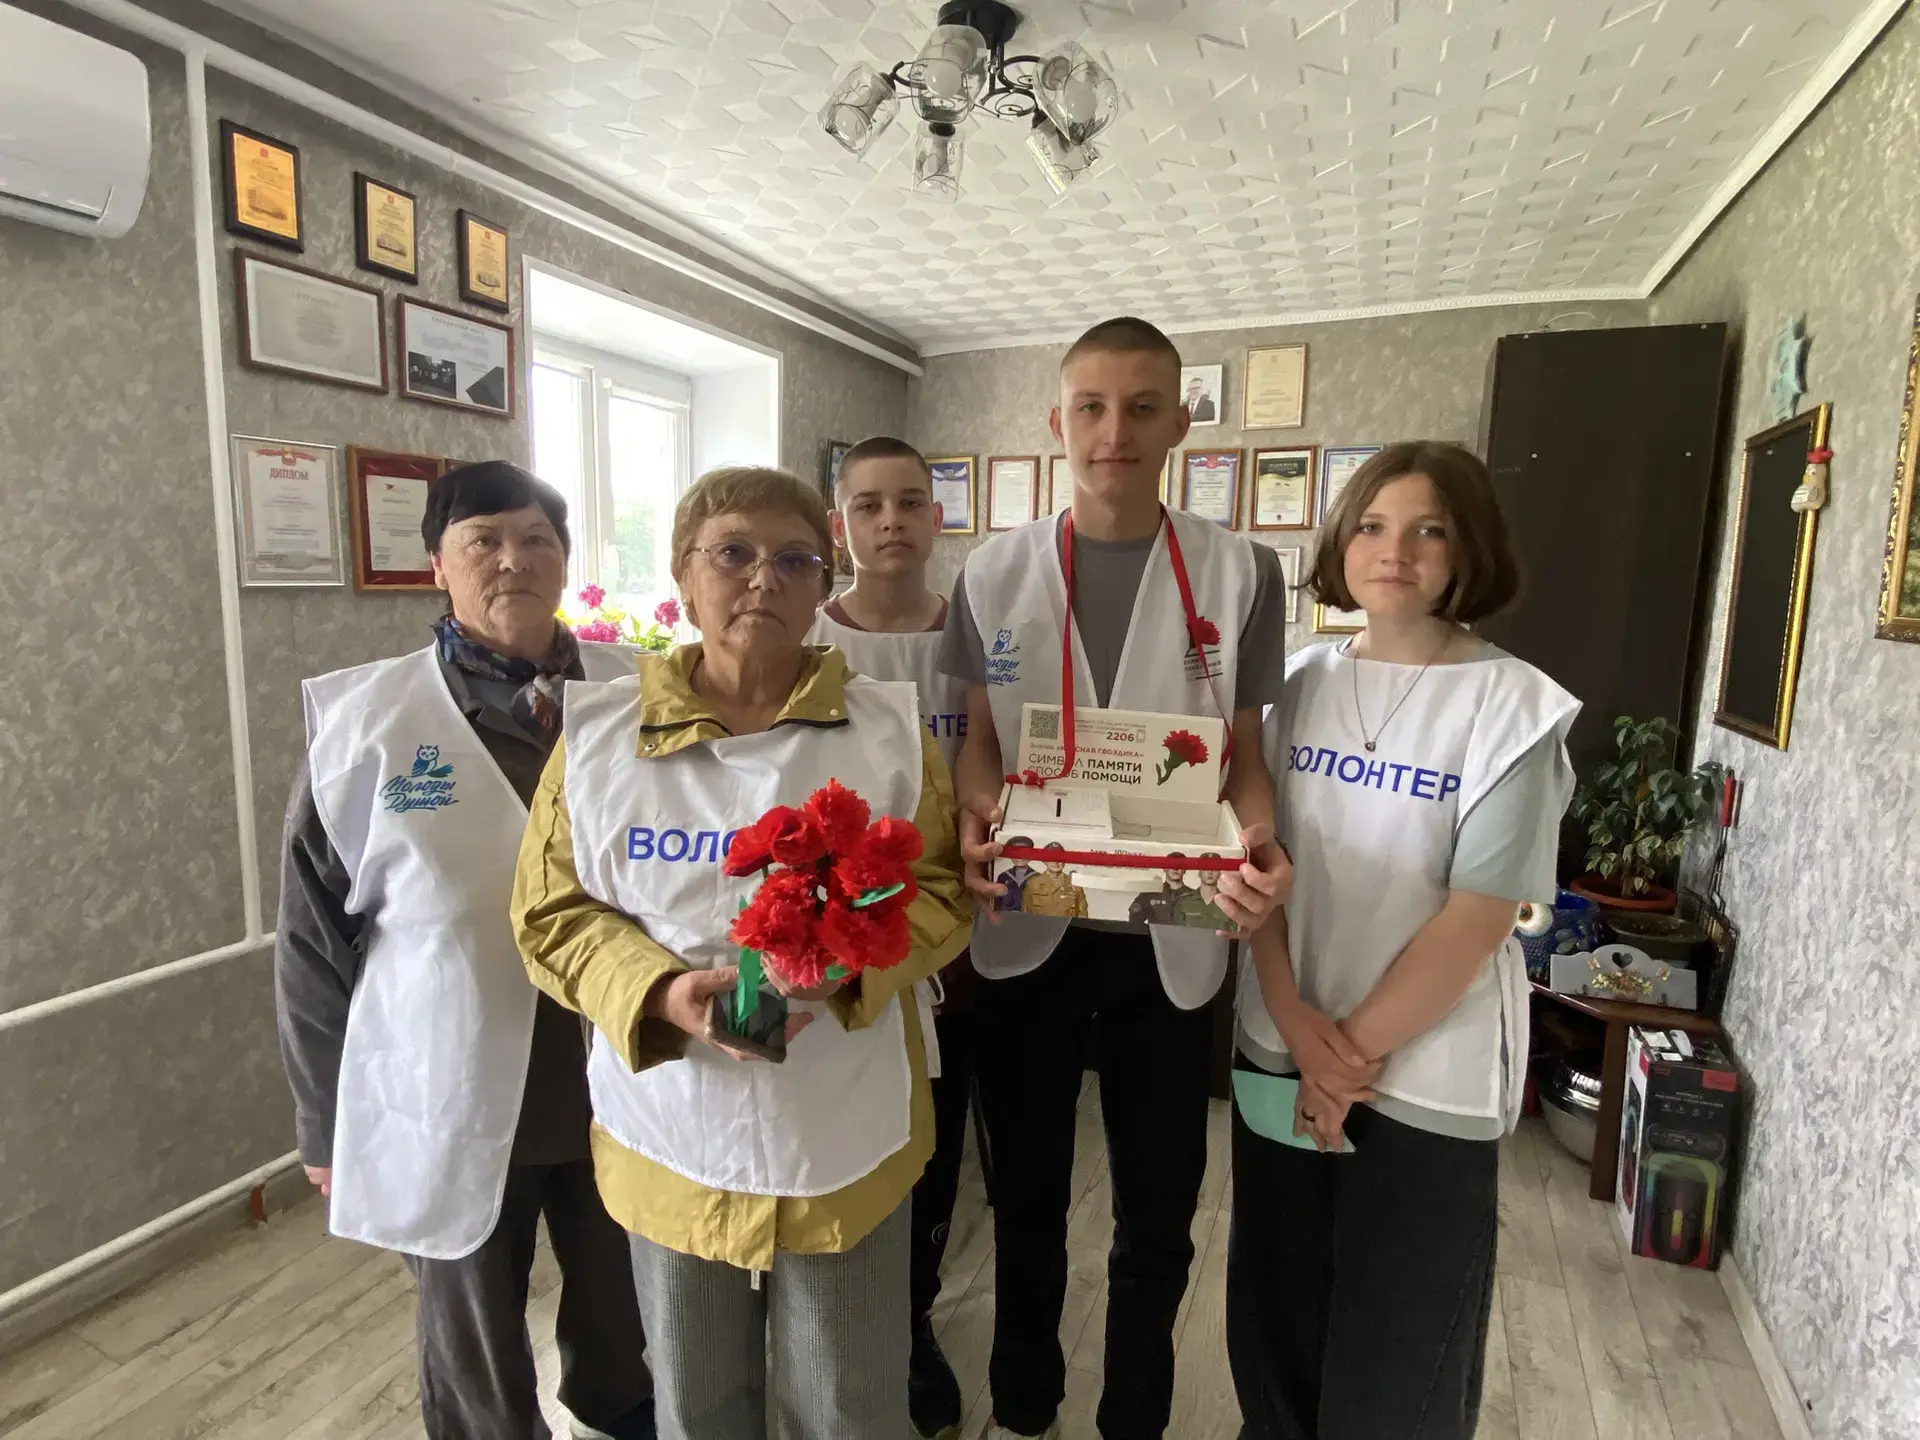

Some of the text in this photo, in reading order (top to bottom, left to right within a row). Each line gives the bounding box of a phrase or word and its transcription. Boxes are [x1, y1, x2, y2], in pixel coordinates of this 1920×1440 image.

[270, 468, 309, 481] ДИПЛОМ
[1106, 731, 1135, 742] 2206
[1028, 753, 1142, 773] СИМВЛ ПАМЯТИ
[379, 775, 456, 797] Молоды
[1081, 771, 1141, 785] ПОМОЩИ
[384, 792, 460, 813] Душой
